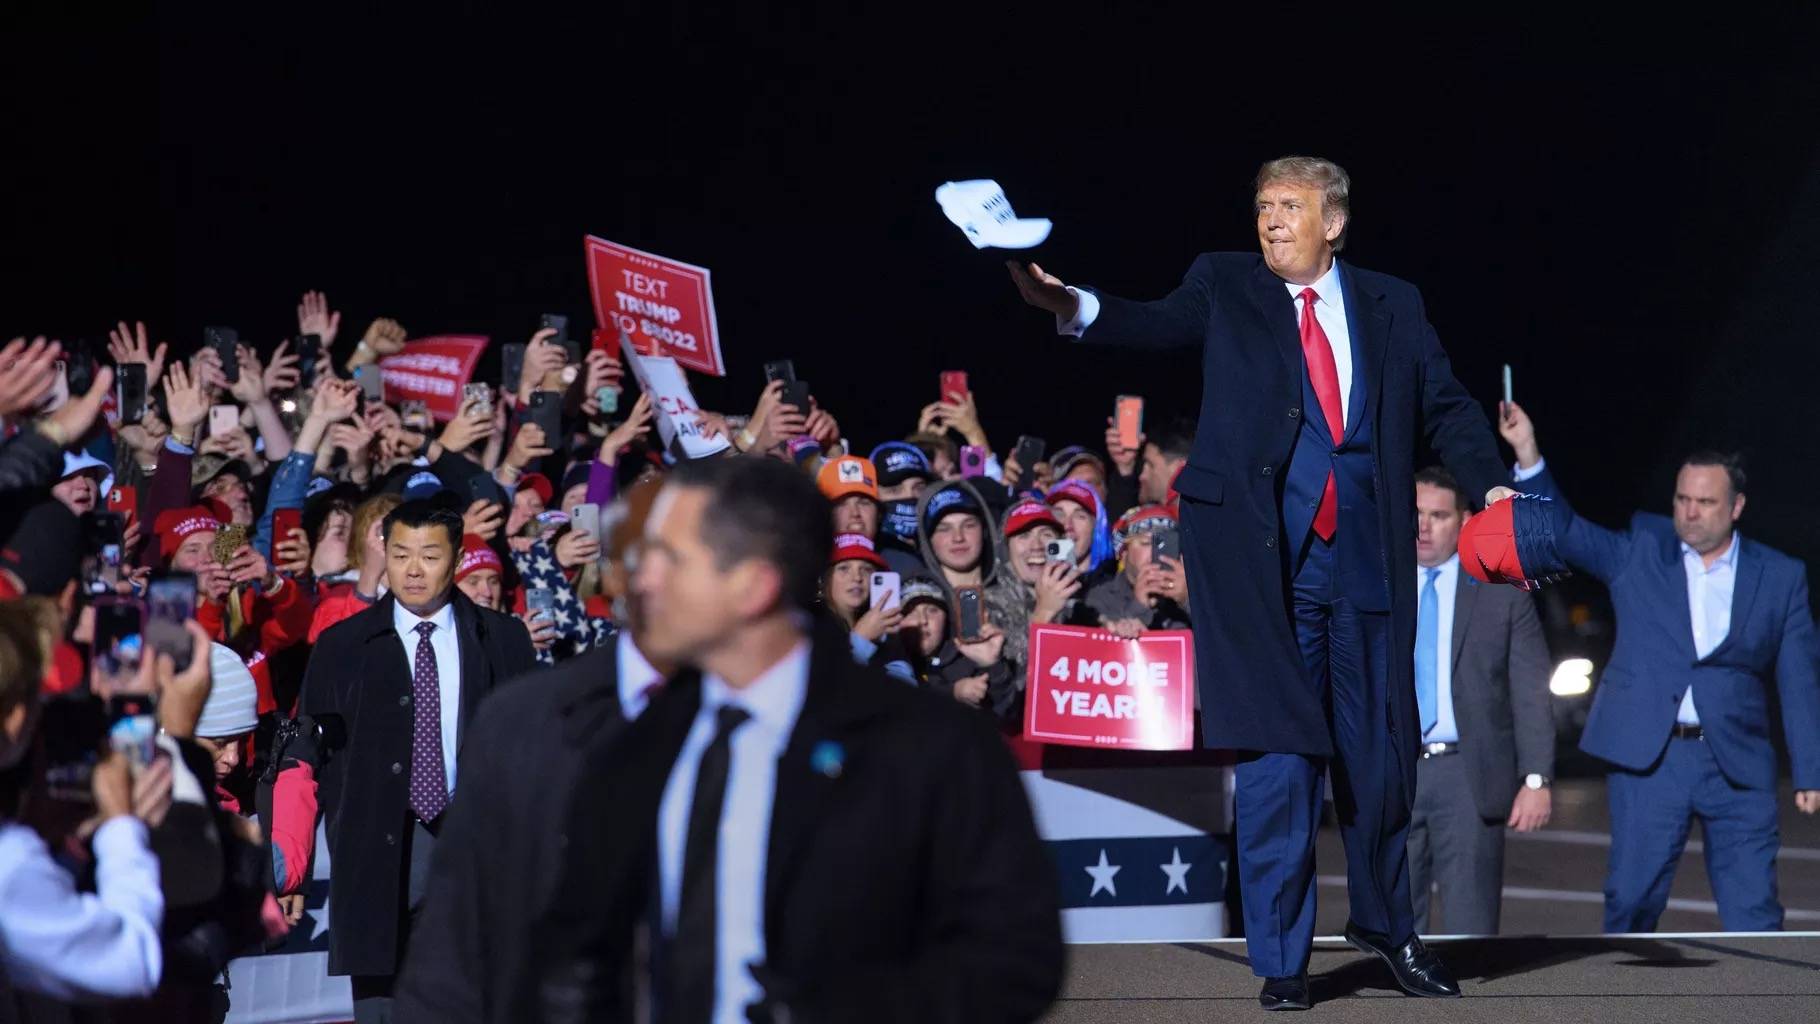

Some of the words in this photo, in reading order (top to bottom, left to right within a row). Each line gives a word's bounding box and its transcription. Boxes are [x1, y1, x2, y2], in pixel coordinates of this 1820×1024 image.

[622, 269, 668, 299] TEXT
[609, 310, 636, 334] TO
[615, 290, 681, 324] TRUMP
[1050, 656, 1070, 681] 4
[1077, 658, 1168, 687] MORE
